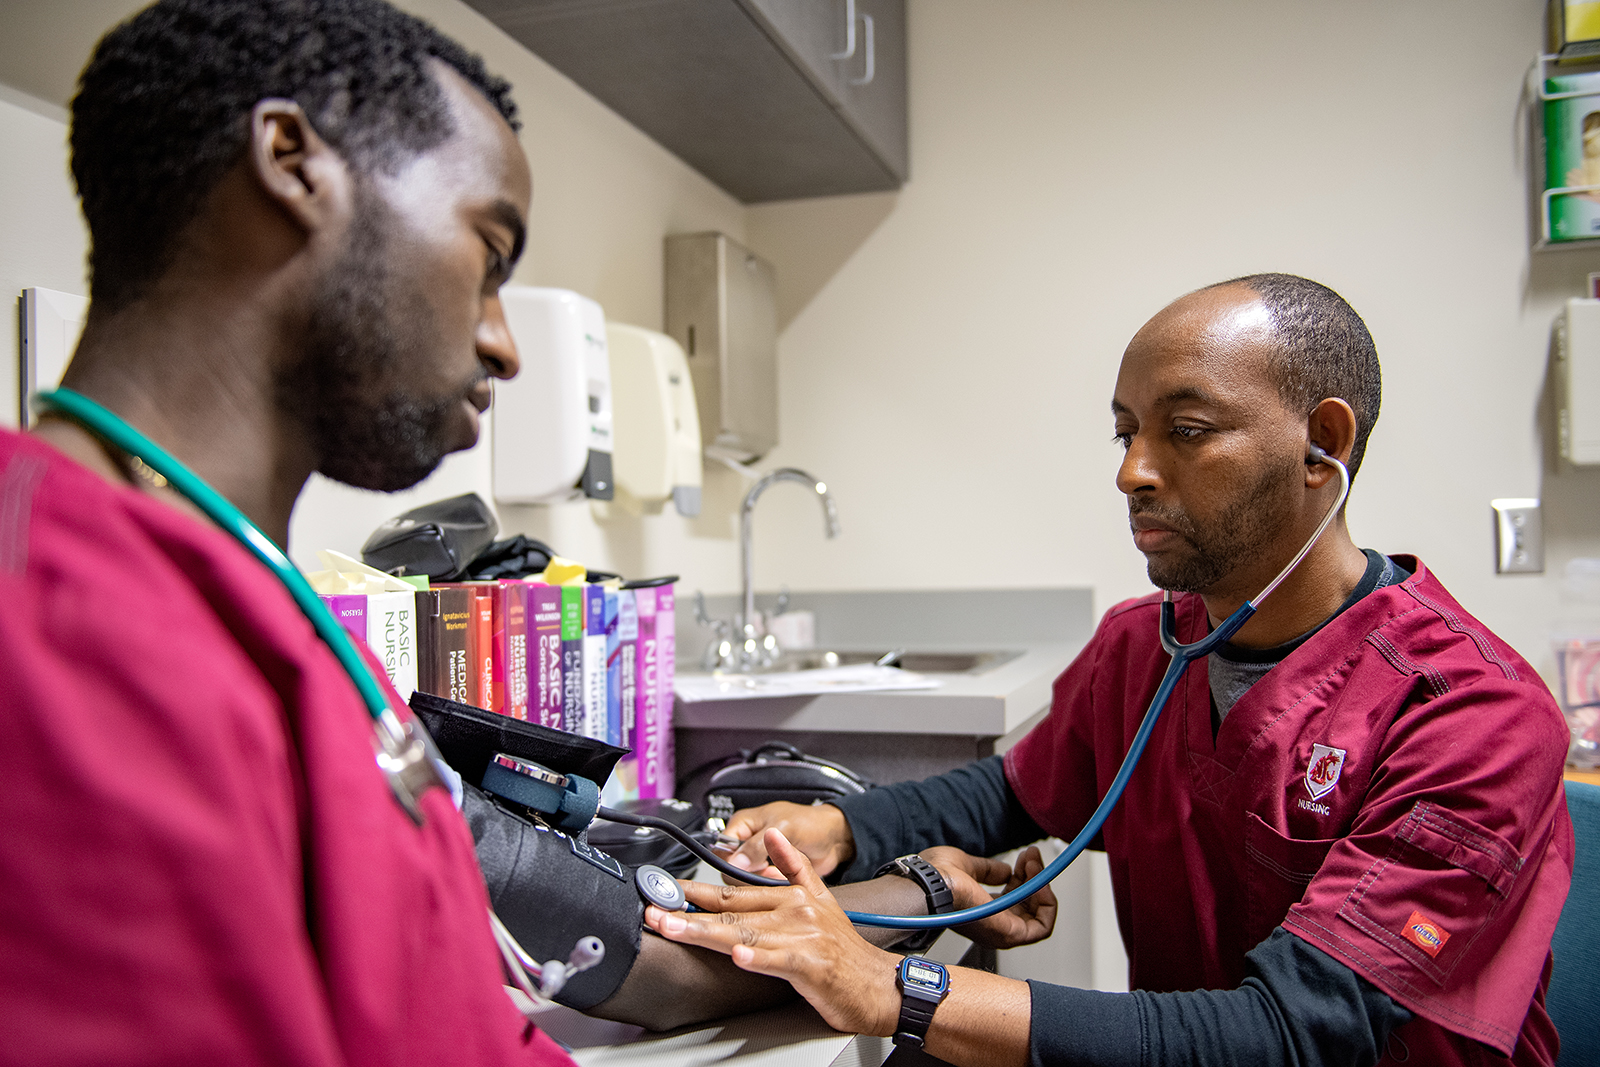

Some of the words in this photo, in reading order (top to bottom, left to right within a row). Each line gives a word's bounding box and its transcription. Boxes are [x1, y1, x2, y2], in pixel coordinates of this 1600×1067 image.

[341, 609, 363, 617] PEARSON
[398, 610, 410, 667] BASIC
[539, 634, 548, 708] Concepts,
[549, 634, 560, 708] BASIC
[644, 639, 658, 785] NURSING
[1297, 798, 1330, 816] NURSING
